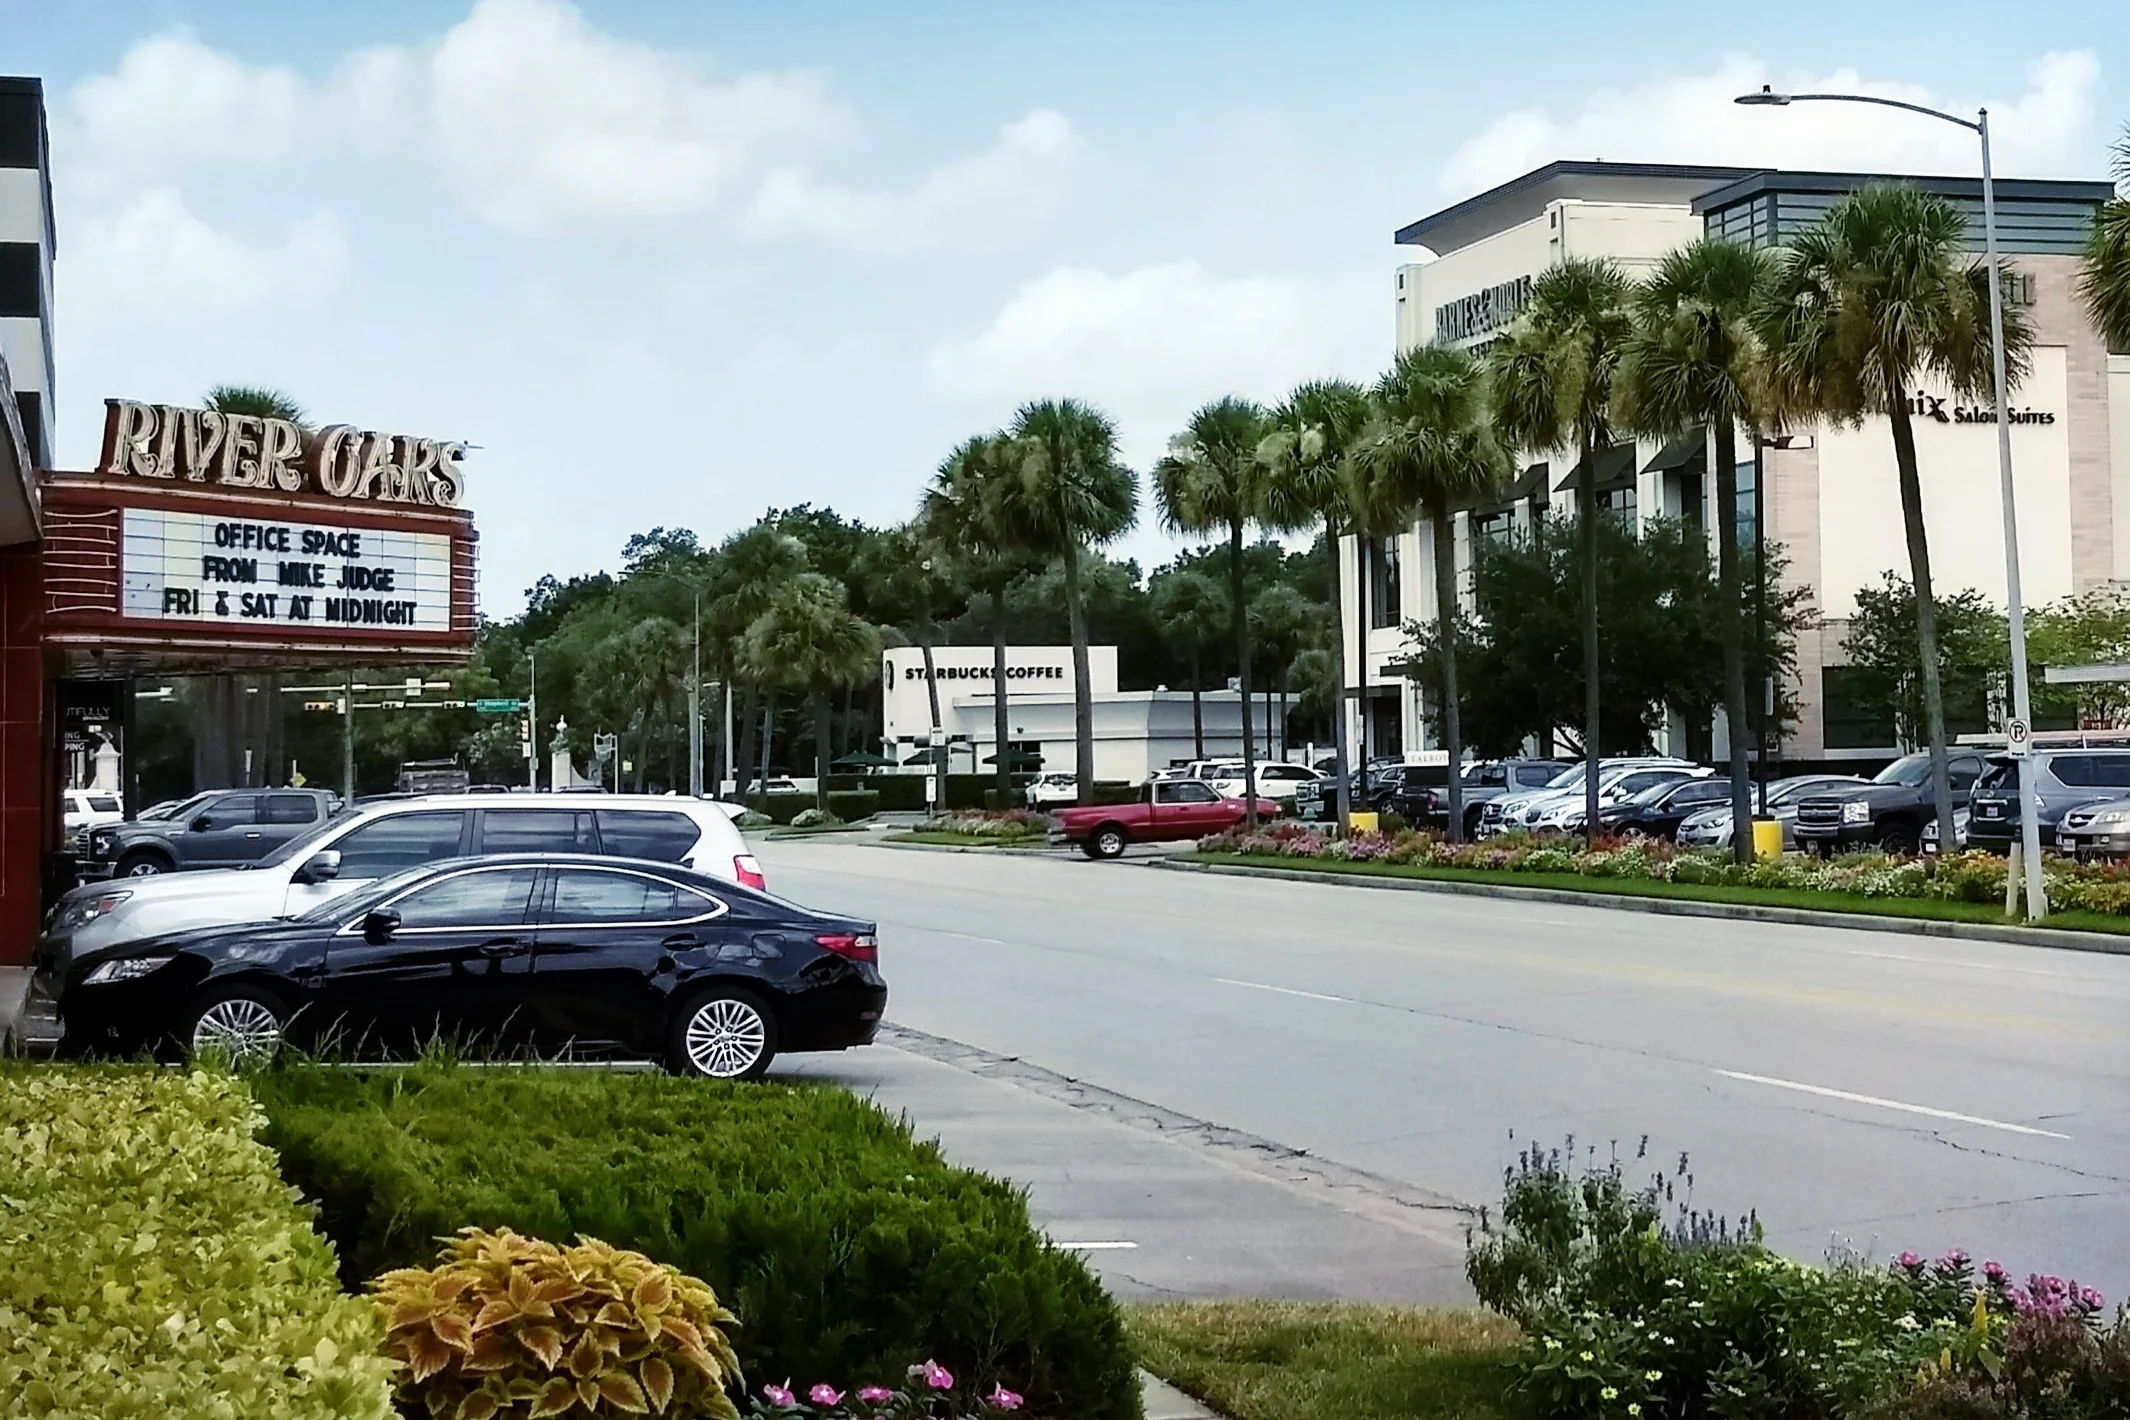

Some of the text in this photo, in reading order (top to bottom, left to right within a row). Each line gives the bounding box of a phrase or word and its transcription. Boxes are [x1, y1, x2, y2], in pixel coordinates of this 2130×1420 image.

[1435, 293, 1480, 344] BARNES
[1478, 288, 1491, 333] &
[105, 398, 468, 507] RIVER OAKS
[214, 522, 361, 558] OFFICE SPACE
[203, 555, 395, 592] FROM MIKE JUDGE
[163, 586, 418, 625] FRI & SAT AT MIDNIGHT
[1005, 667, 1064, 679] COFFEE
